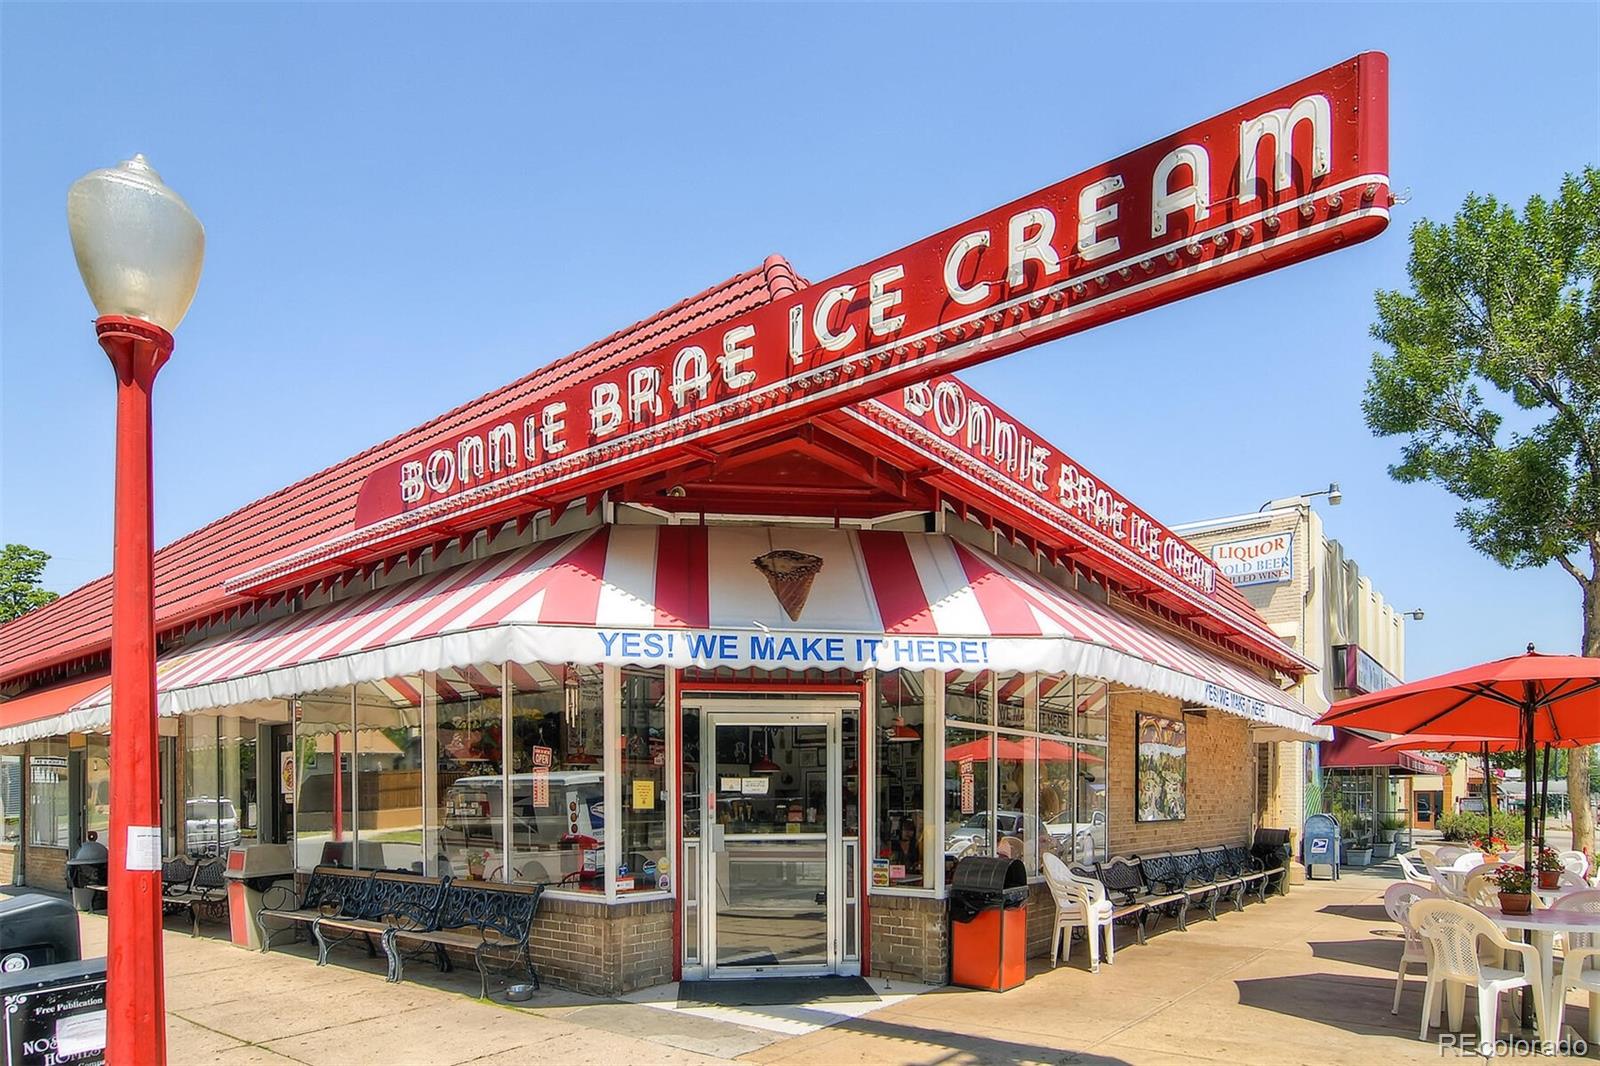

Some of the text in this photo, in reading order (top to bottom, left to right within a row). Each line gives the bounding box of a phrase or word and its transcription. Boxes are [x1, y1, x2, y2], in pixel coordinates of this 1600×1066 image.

[399, 94, 1333, 503] BONNIE BRAE ICE CREAM
[903, 379, 1216, 594] BONNIE BRAE ICE CREAM
[1219, 537, 1285, 562] LIQUOR
[1257, 556, 1289, 571] BEER
[1259, 570, 1289, 579] WINES
[597, 632, 989, 664] YES! WE MAKE IT HERE!
[535, 753, 549, 765] OPEN
[35, 997, 103, 1016] Free Publication
